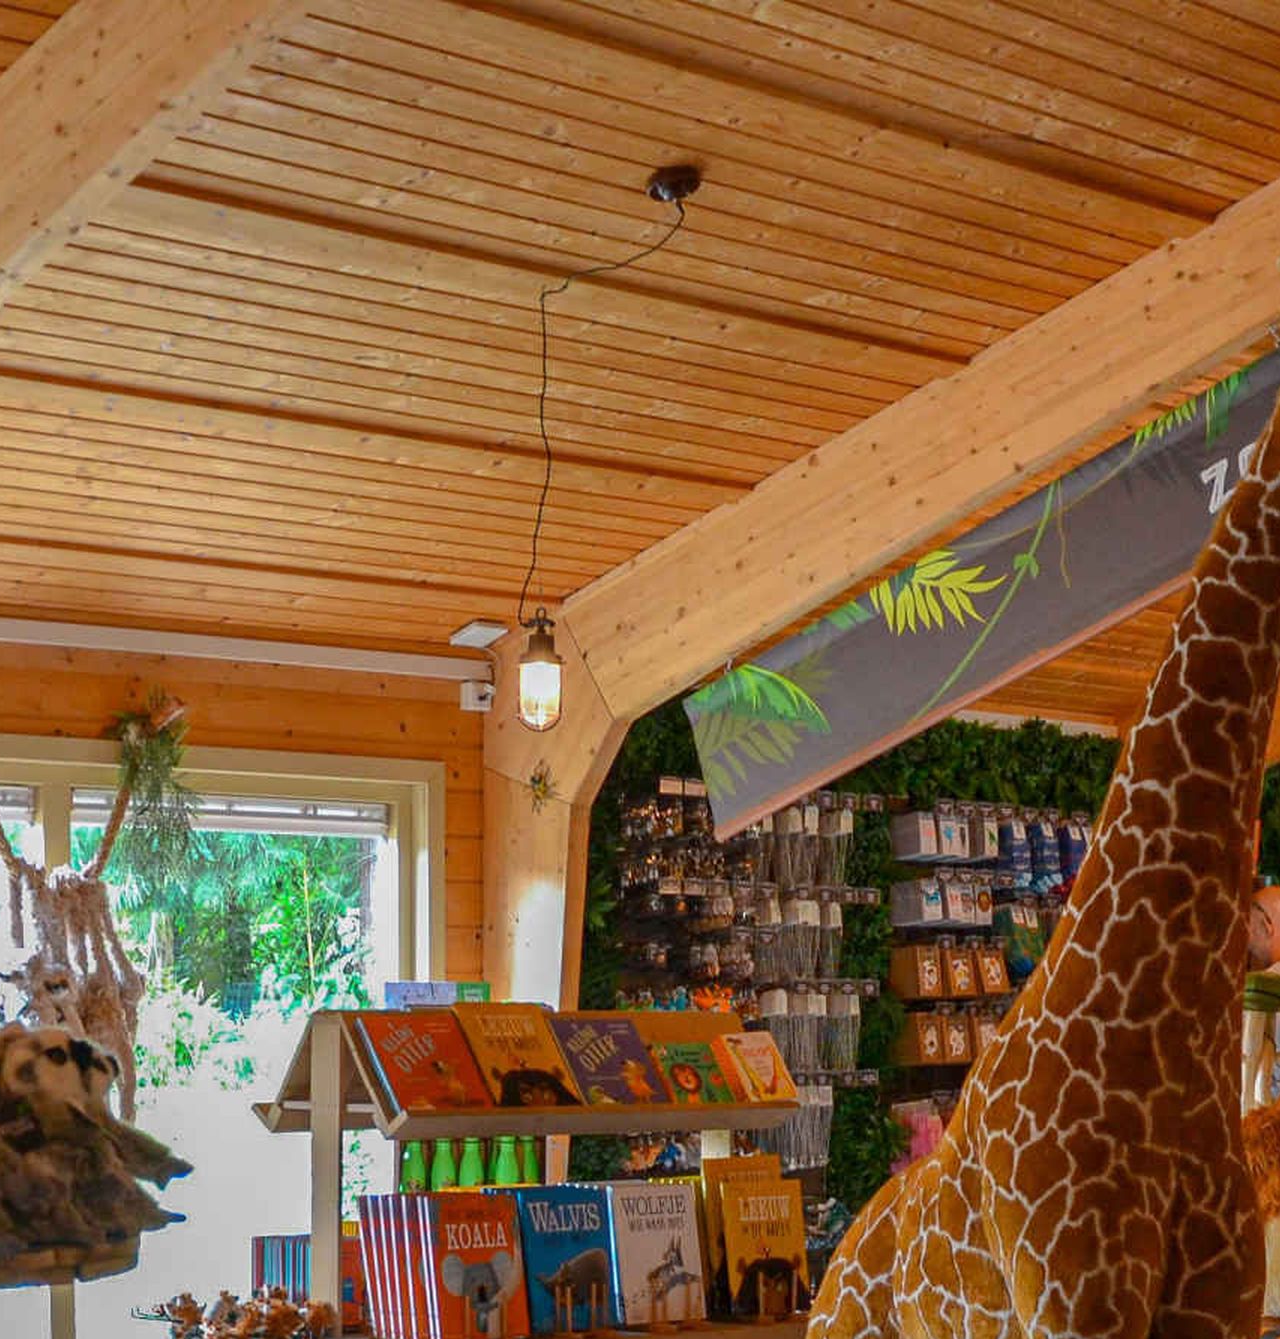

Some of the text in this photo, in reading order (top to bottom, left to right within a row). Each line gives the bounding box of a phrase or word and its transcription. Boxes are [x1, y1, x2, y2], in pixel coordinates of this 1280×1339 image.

[527, 1200, 602, 1233] WALVIS
[620, 1194, 687, 1218] WOLFJE
[739, 1195, 792, 1222] LEEUW
[445, 1221, 509, 1250] KOALA
